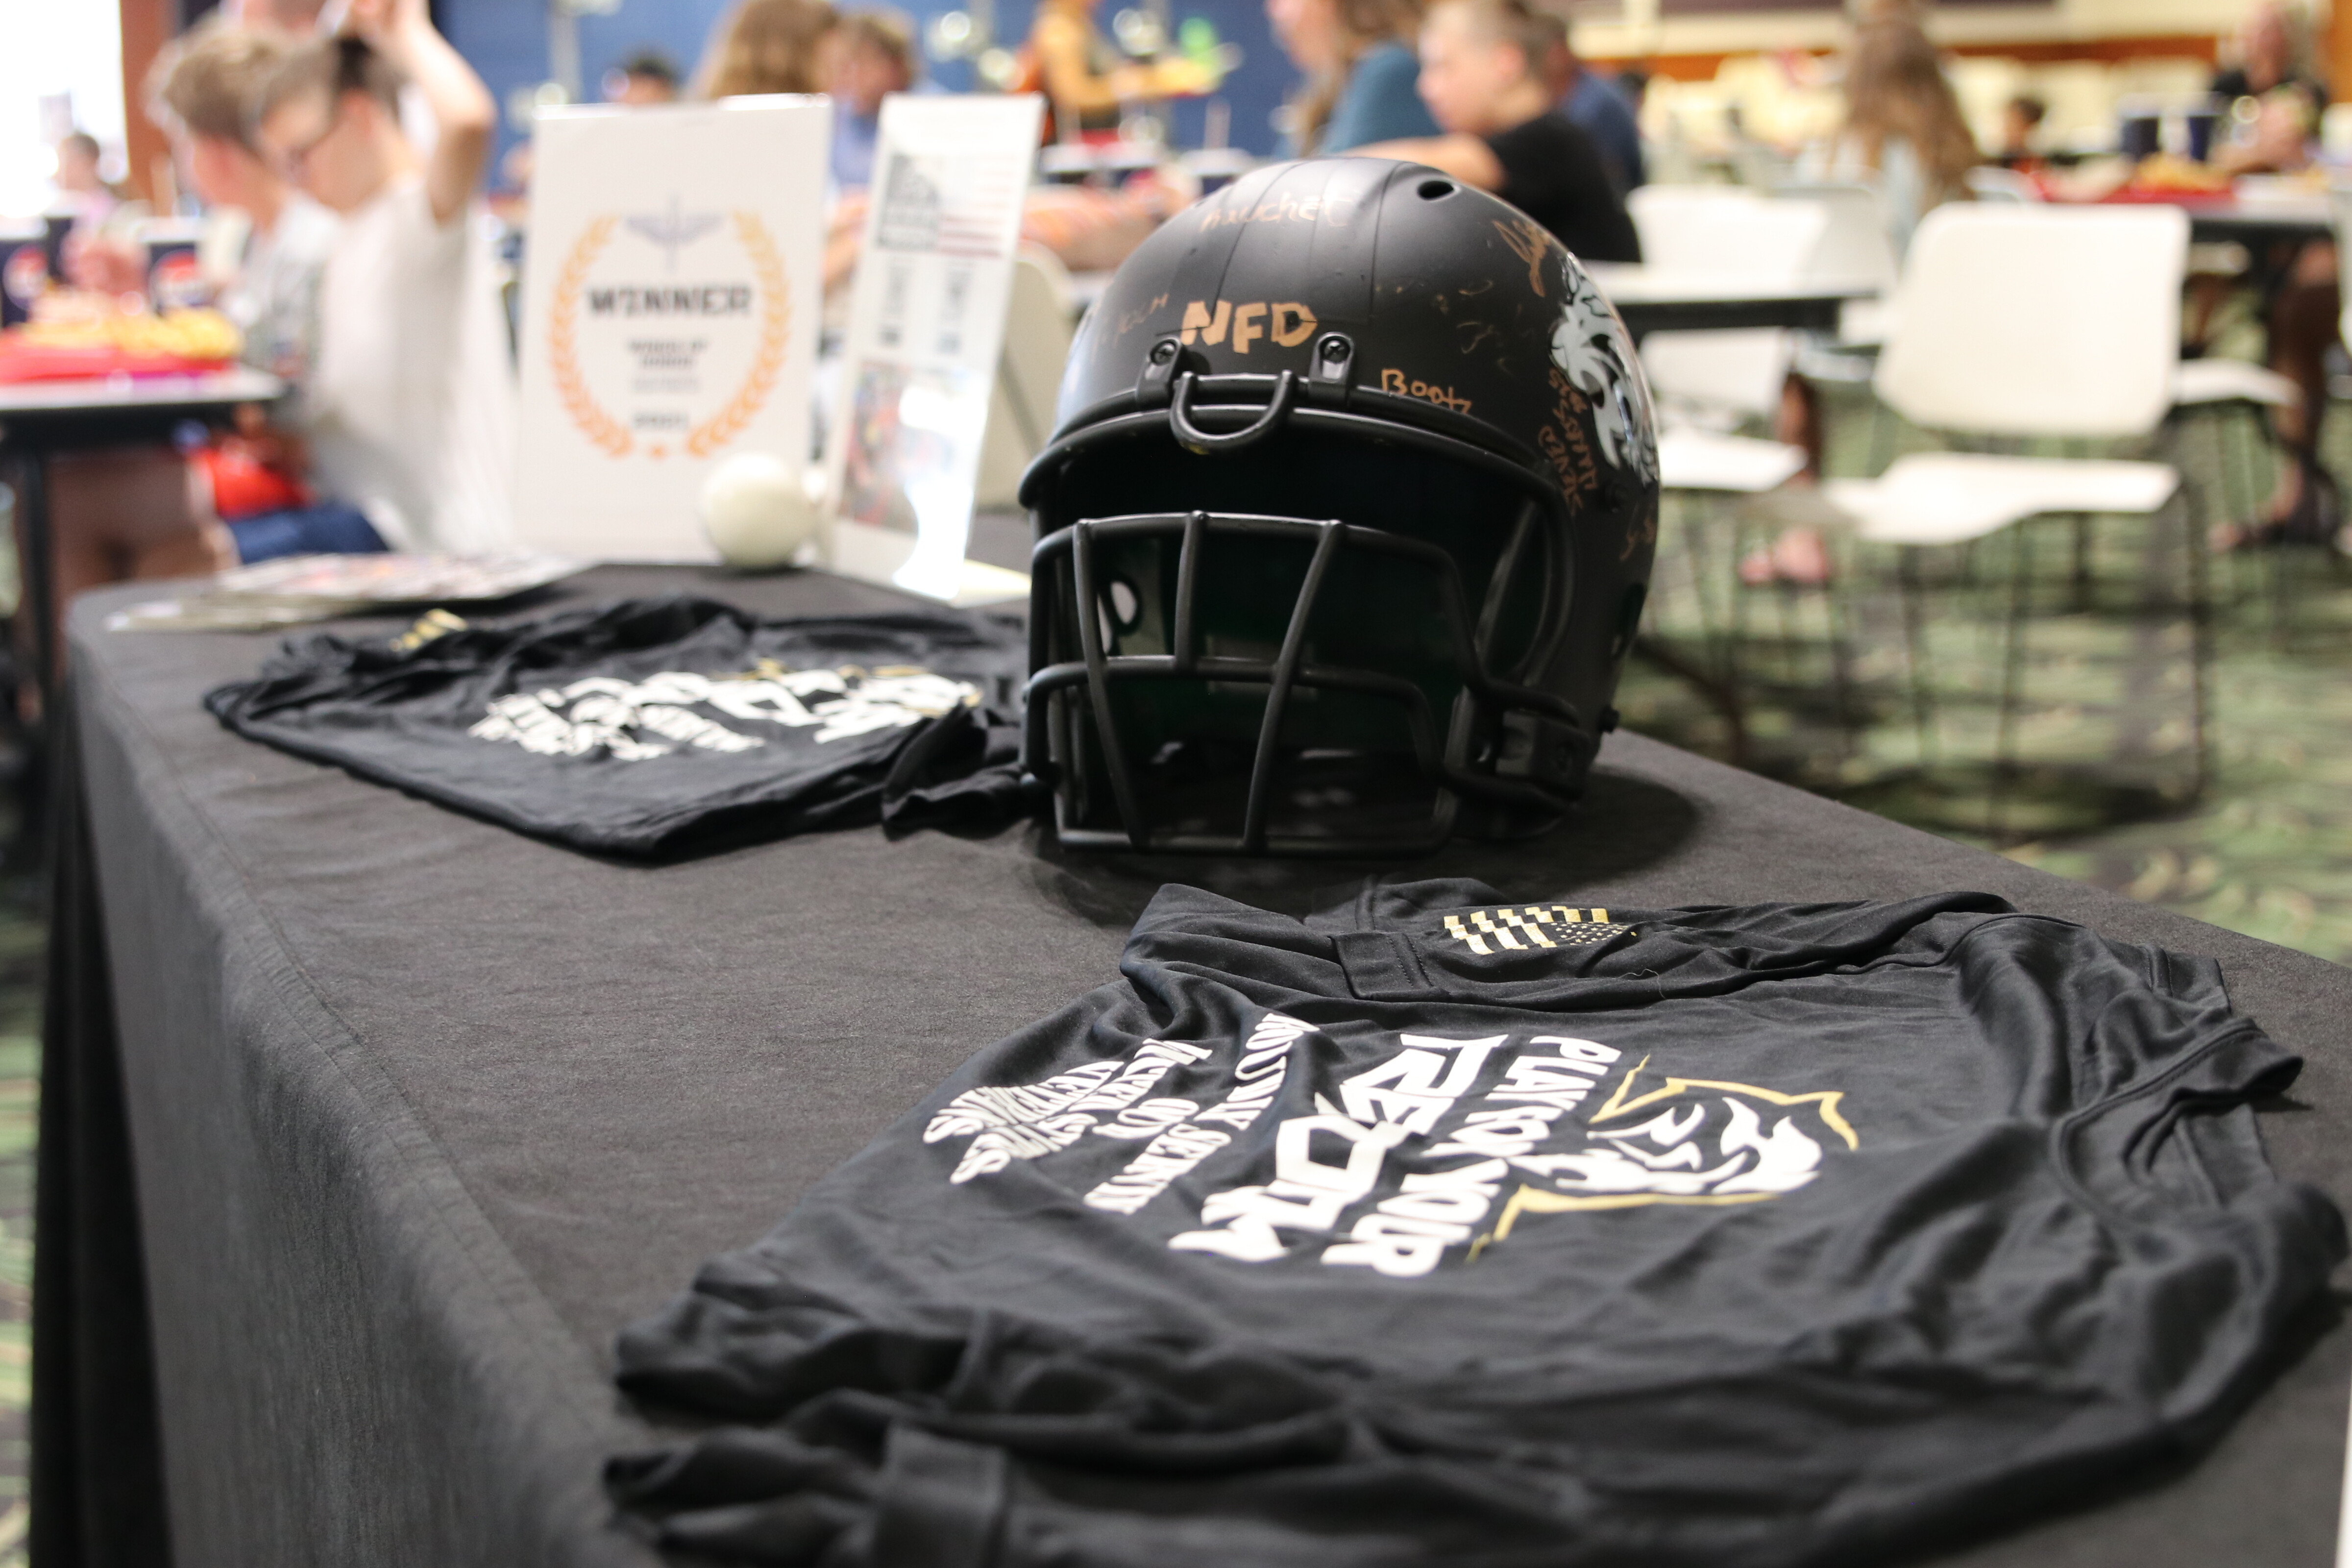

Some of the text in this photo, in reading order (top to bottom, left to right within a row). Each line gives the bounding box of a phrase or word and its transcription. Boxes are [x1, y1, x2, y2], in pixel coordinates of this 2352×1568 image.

[589, 285, 752, 315] WINNER
[1180, 299, 1318, 354] NFD
[1194, 1013, 1320, 1131] ROUDLY
[1321, 1035, 1622, 1277] PLAY FOR YOUR
